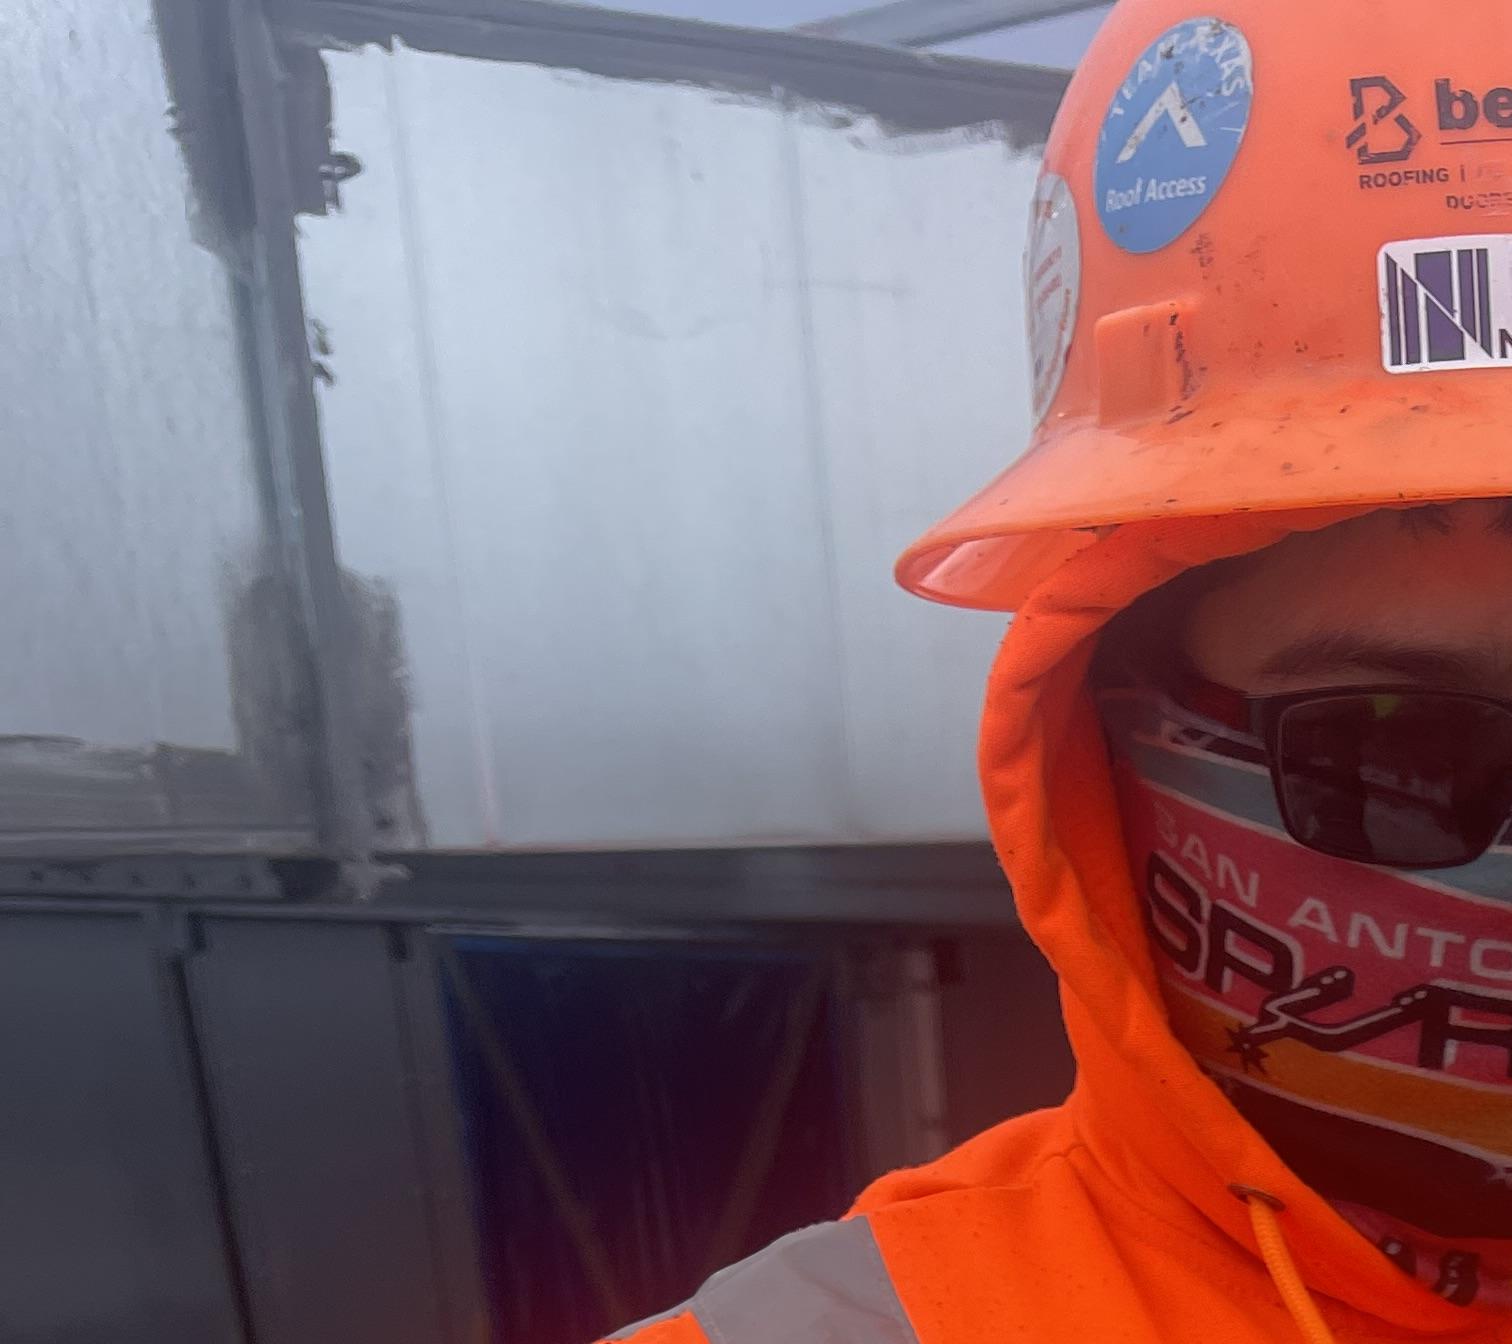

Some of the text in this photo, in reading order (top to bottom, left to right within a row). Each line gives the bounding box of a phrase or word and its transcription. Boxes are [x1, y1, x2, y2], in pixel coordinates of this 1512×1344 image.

[1105, 176, 1207, 213] Roof Access
[1359, 168, 1450, 190] ROOFING
[1153, 800, 1261, 909] SAN
